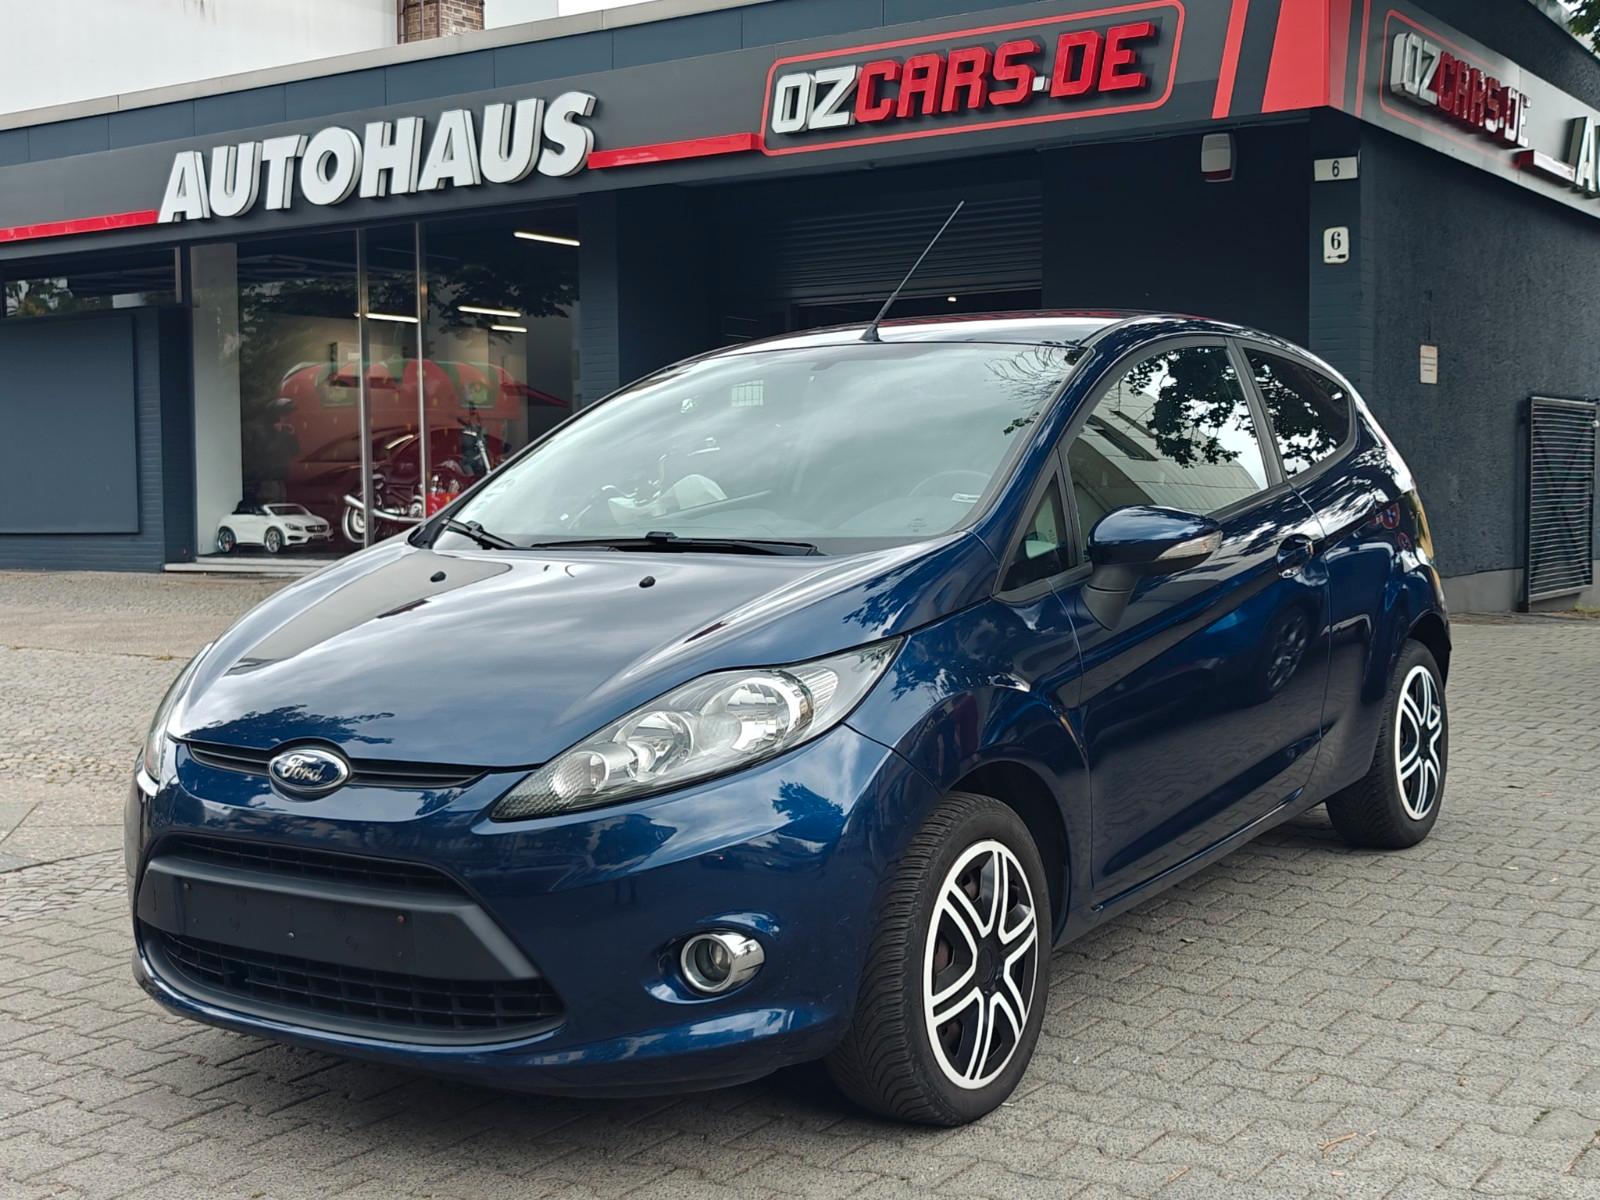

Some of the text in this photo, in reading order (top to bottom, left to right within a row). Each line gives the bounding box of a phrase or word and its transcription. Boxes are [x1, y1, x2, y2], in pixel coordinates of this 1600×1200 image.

[770, 21, 1157, 135] OZCARS.DE
[157, 91, 597, 224] AUTOHAUS
[1331, 159, 1340, 178] 6
[1330, 230, 1342, 251] 6
[282, 754, 326, 782] Ford
